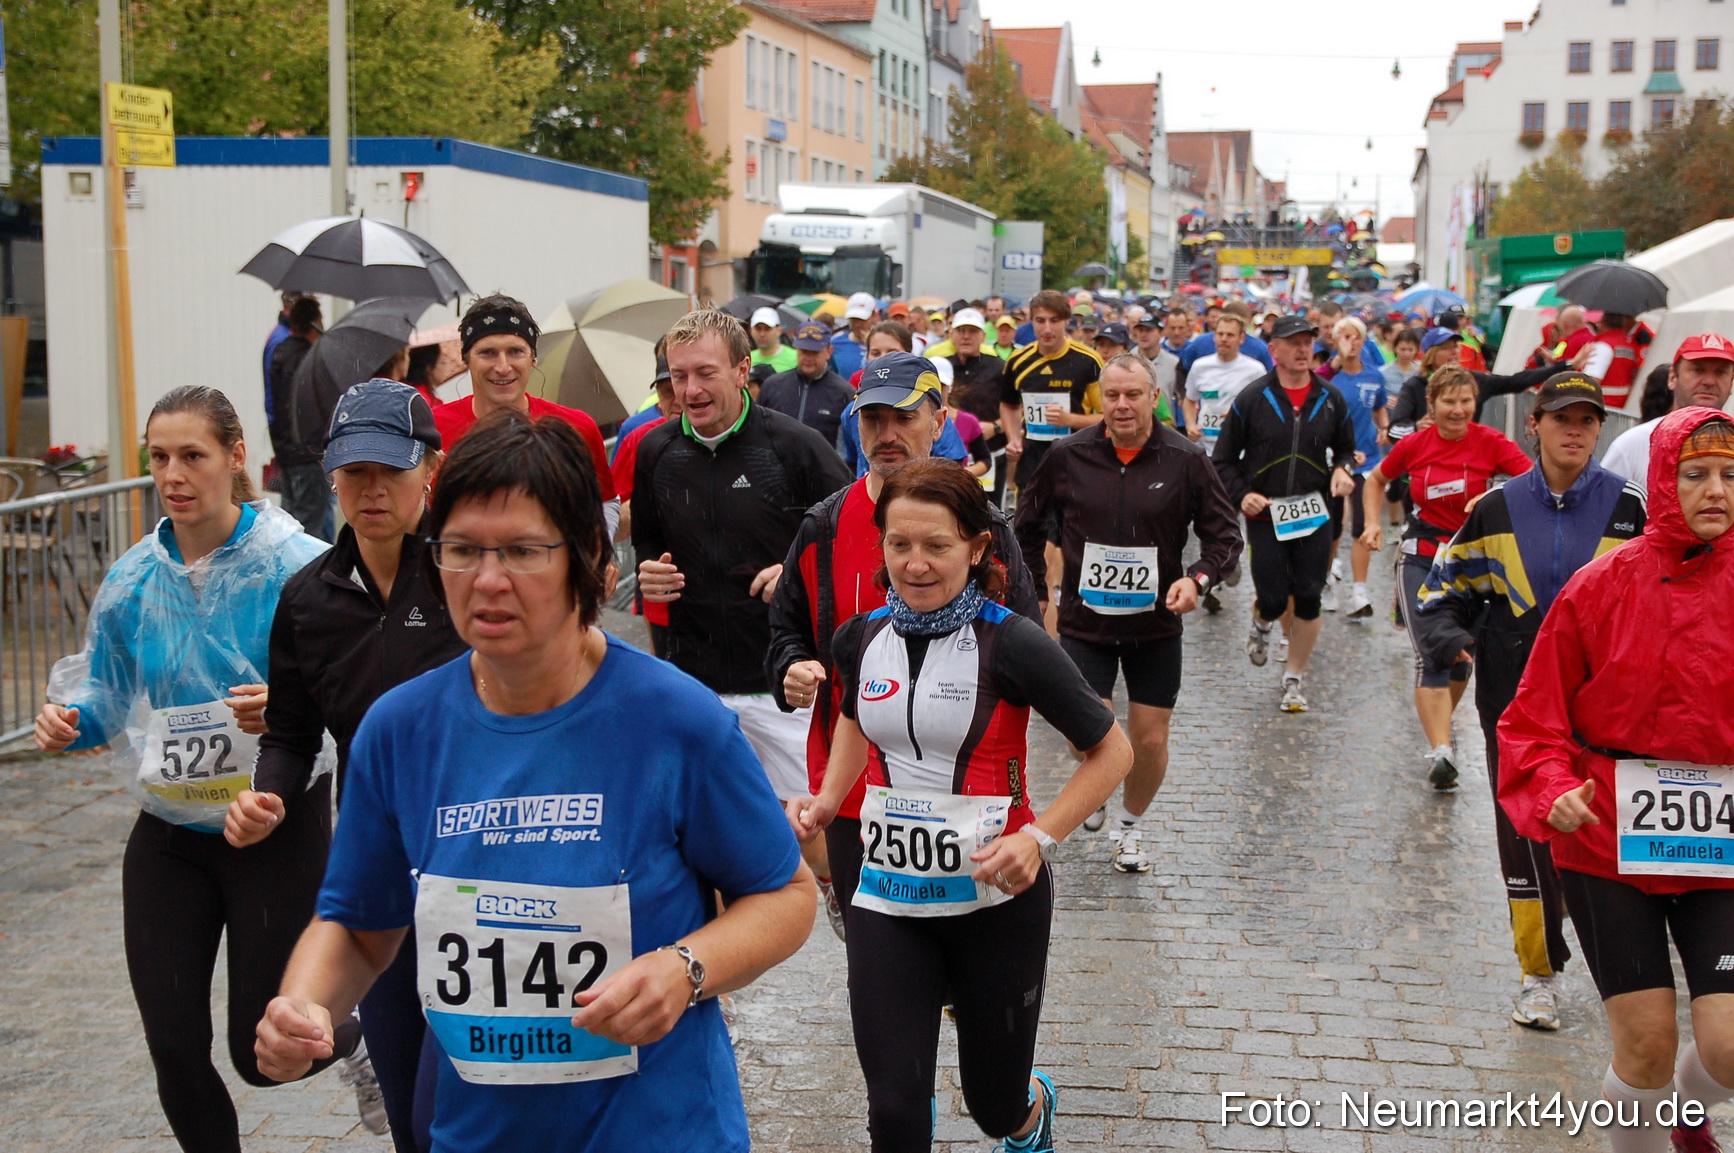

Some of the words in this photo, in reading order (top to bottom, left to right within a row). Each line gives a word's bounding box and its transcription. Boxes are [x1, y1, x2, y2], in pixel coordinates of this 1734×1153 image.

[791, 226, 852, 239] BOCK
[1254, 252, 1293, 260] START
[1203, 414, 1222, 428] 32
[1277, 498, 1321, 521] 2846
[1105, 551, 1136, 559] BOCK
[1088, 563, 1150, 590] 3242
[1103, 595, 1131, 605] Erwin
[864, 680, 888, 693] tkn
[929, 693, 960, 701] nürnberg
[168, 711, 211, 727] BOCK
[161, 734, 238, 781] 522
[1657, 768, 1708, 781] BOCK
[886, 797, 932, 813] BOCK
[1632, 790, 1734, 834] 2504
[441, 797, 601, 834] SPORTWEISS
[482, 831, 511, 845] Wir
[514, 828, 547, 844] sind
[551, 827, 602, 844] Sport.
[867, 821, 961, 873] 2506
[1649, 841, 1723, 860] Manuela
[879, 877, 946, 899] Manuela
[476, 894, 557, 919] BOCK
[436, 932, 609, 1009] 3142
[469, 1025, 572, 1060] Birgitta
